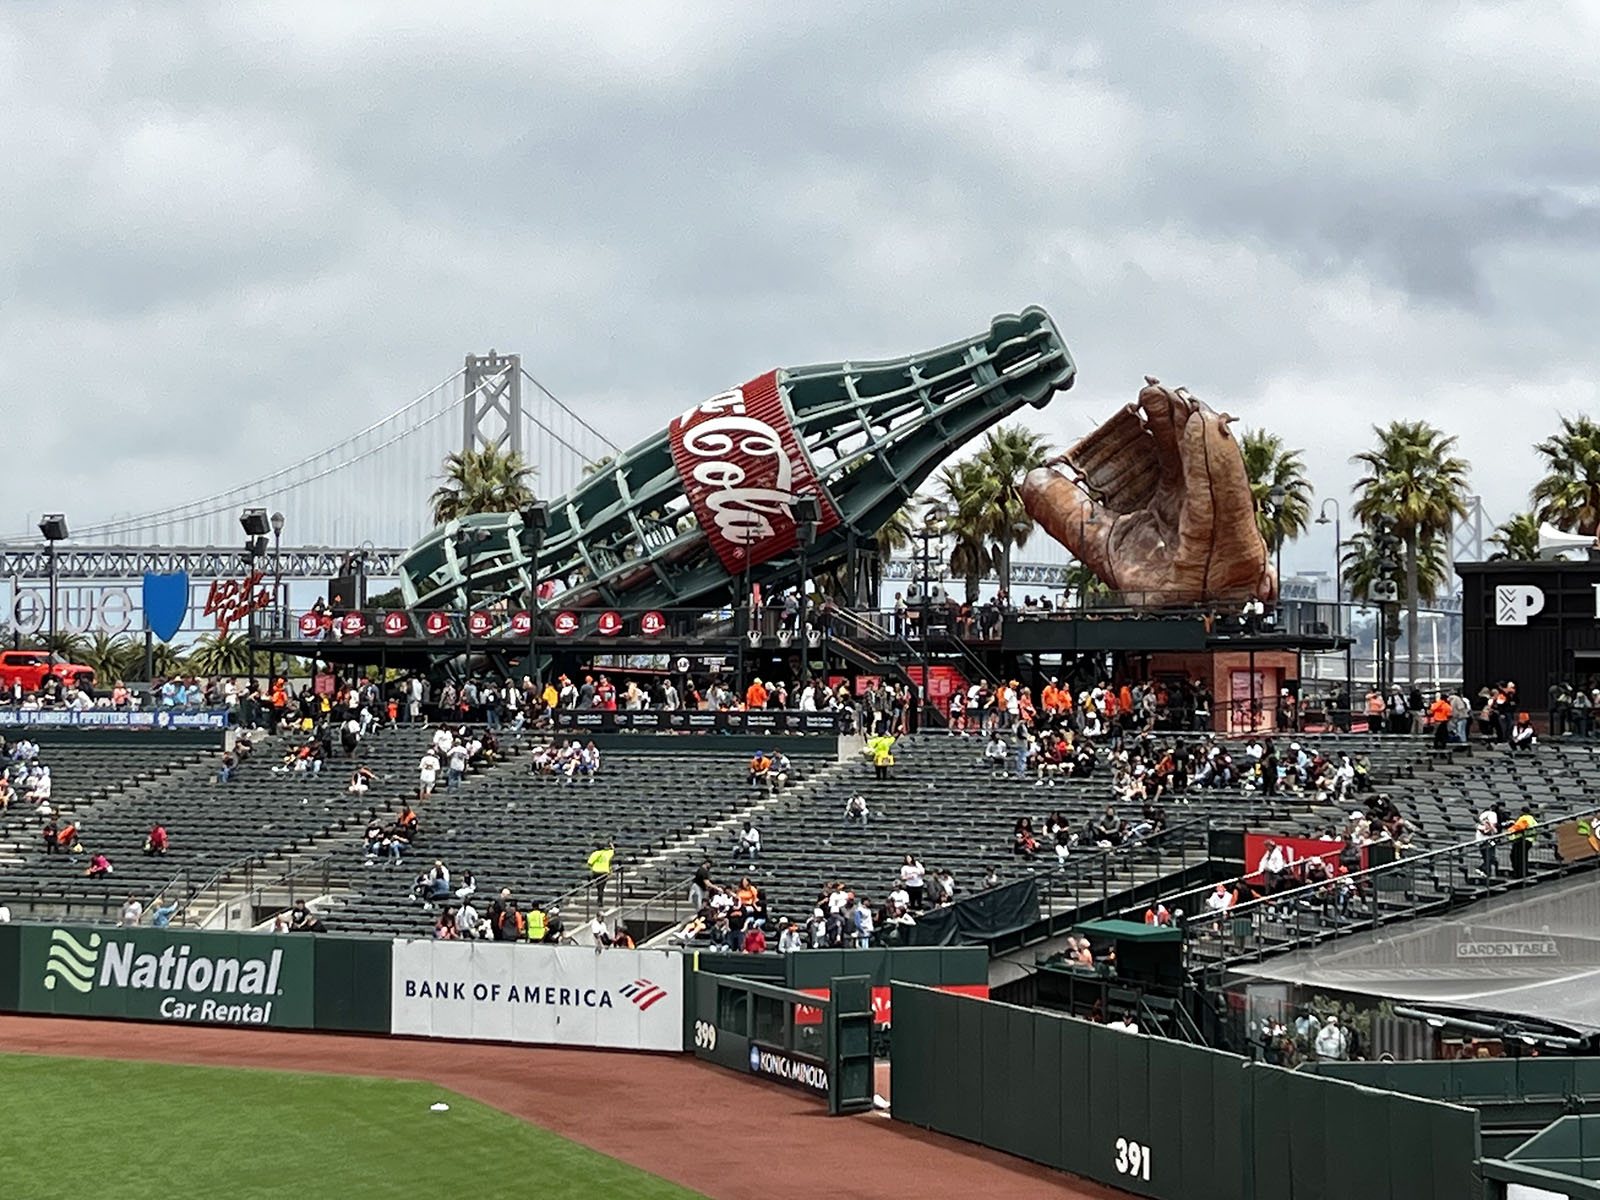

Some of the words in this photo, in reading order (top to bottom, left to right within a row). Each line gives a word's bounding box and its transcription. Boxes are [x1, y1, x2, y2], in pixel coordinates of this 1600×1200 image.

[303, 618, 317, 631] 31
[389, 618, 401, 631] 41
[1460, 943, 1513, 956] GARDEN
[1517, 943, 1557, 954] TABLE
[100, 942, 283, 994] National
[405, 980, 465, 1000] BANK
[473, 983, 501, 1001] OF
[507, 985, 613, 1008] AMERICA
[160, 997, 197, 1018] Car
[200, 999, 272, 1024] Rental
[695, 1020, 716, 1051] 399
[760, 1051, 792, 1078] KONICA
[791, 1061, 829, 1090] MINOLTA
[1115, 1137, 1150, 1181] 391
